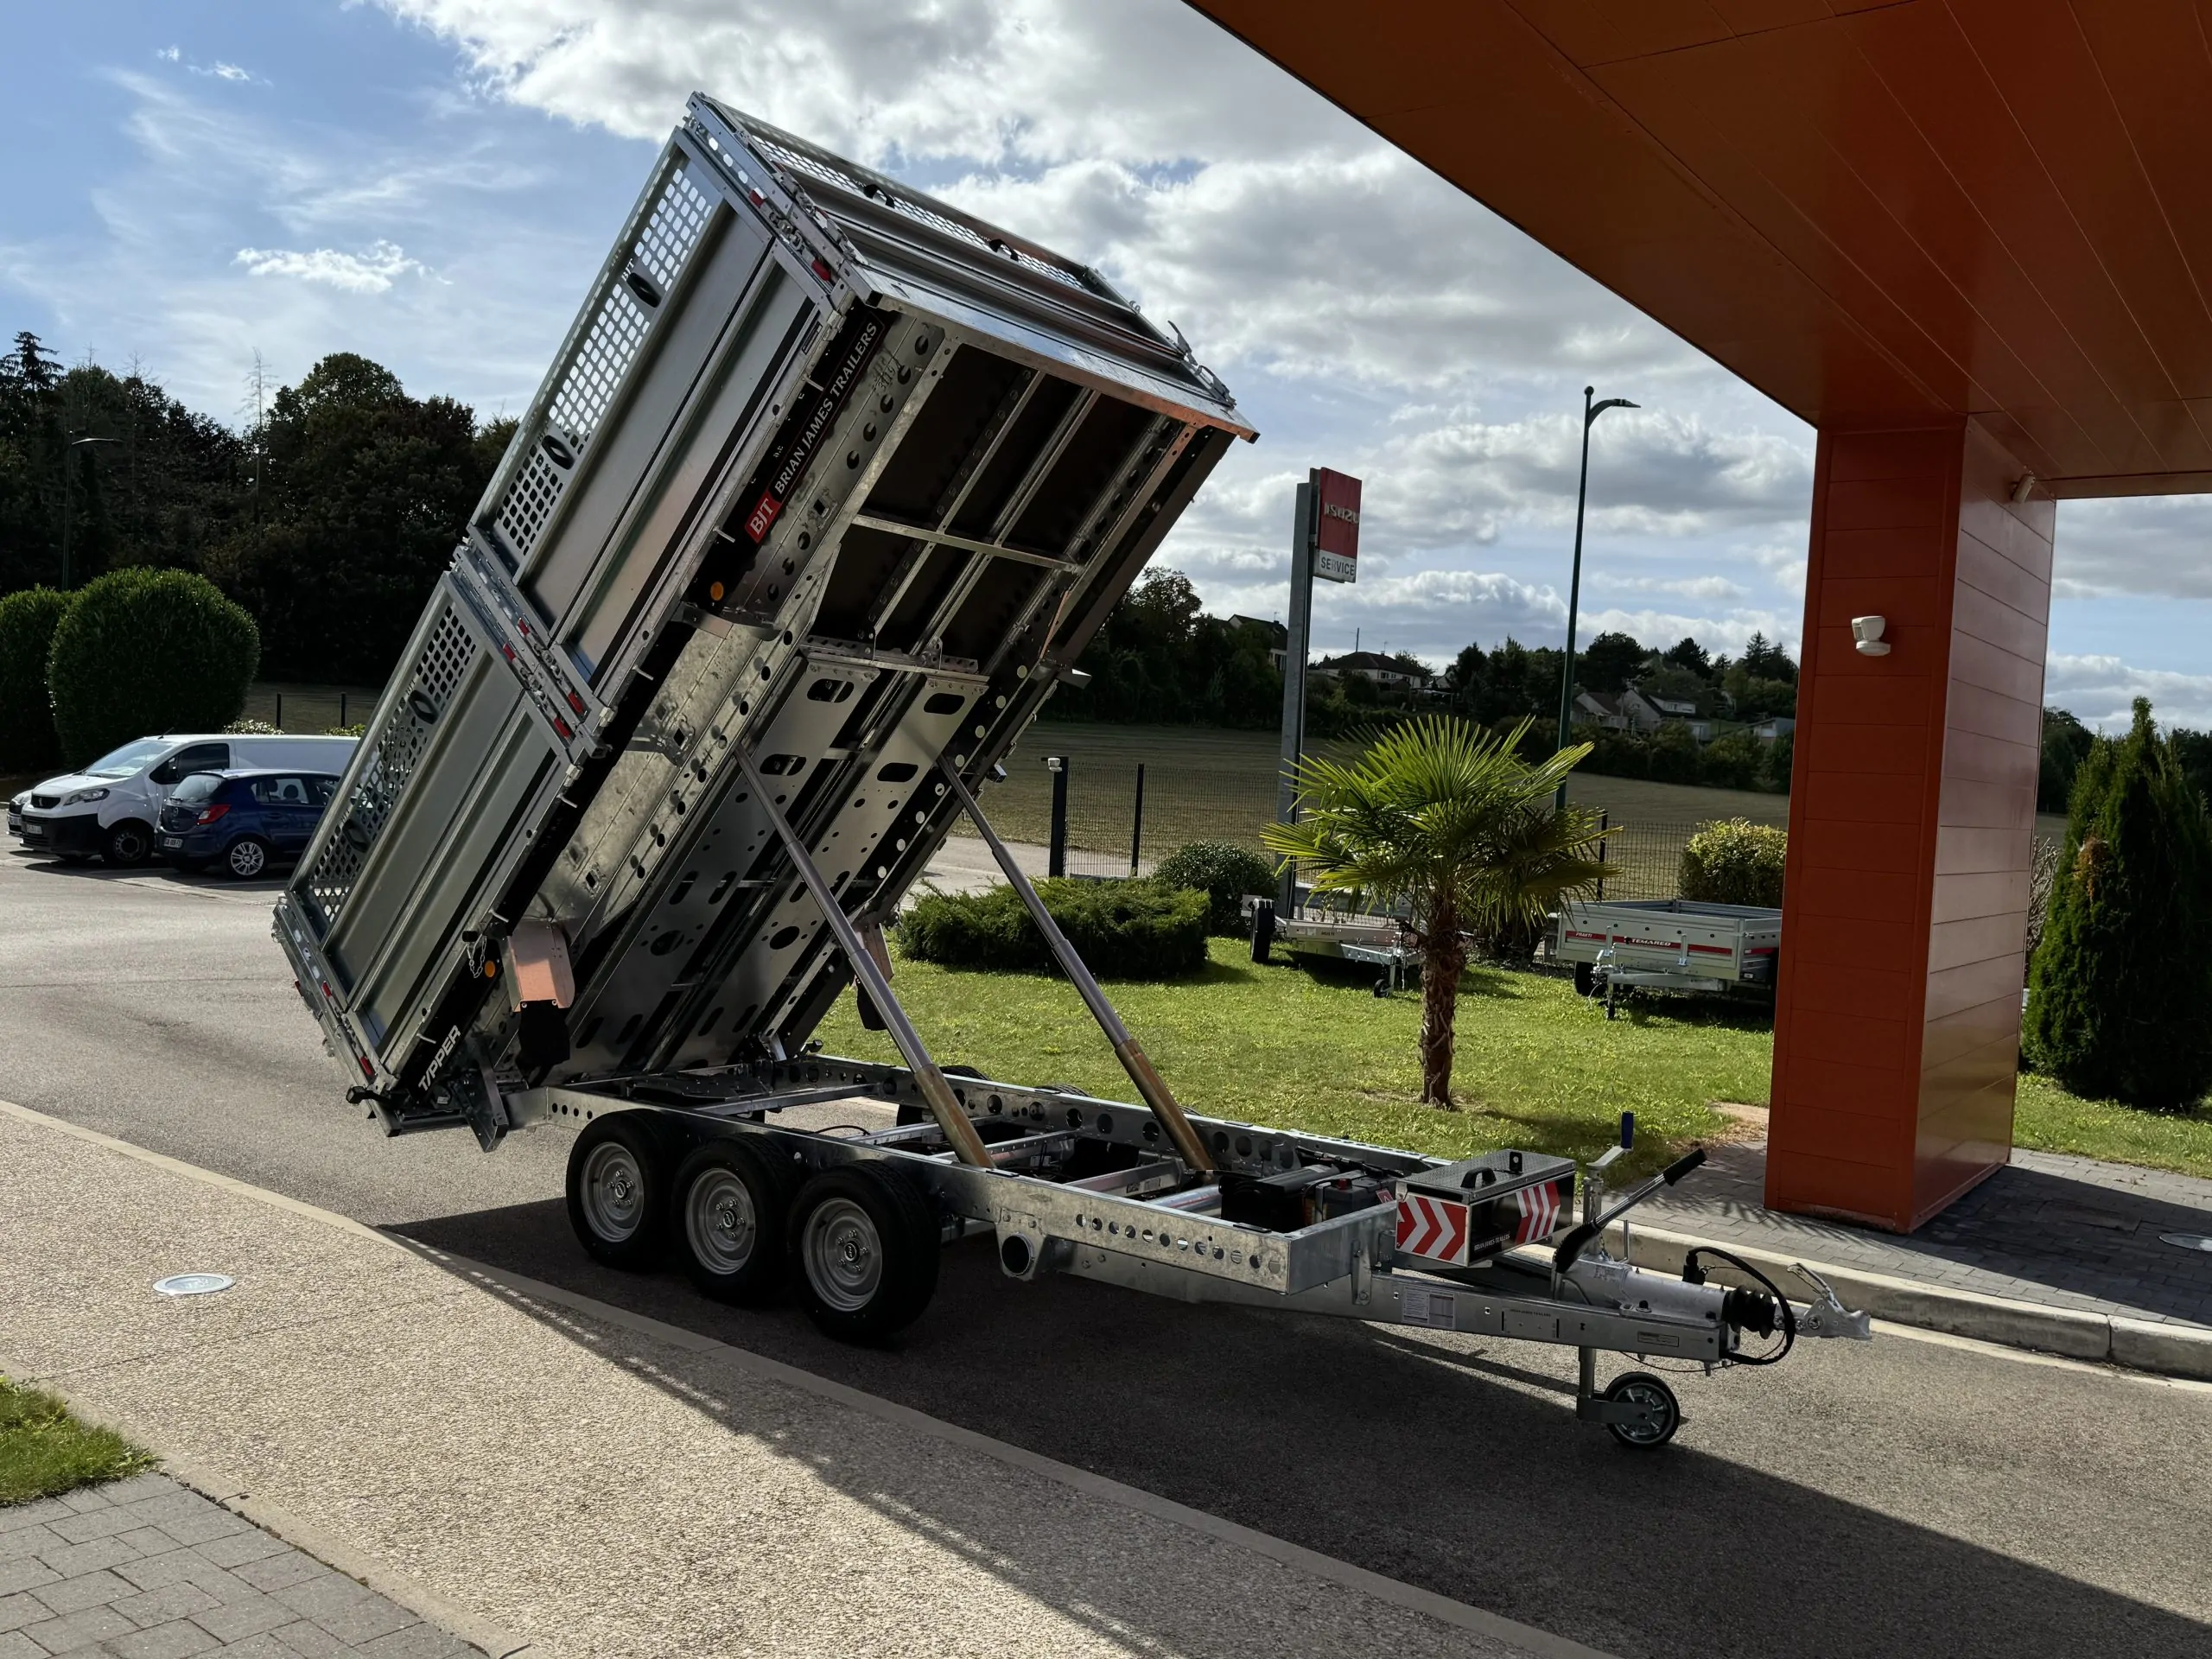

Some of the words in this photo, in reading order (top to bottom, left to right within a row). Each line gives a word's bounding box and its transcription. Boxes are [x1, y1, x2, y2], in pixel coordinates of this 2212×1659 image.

[750, 498, 775, 537] BJT
[774, 447, 805, 495] BRIAN
[801, 398, 834, 449] JAMES
[830, 321, 877, 397] TRAILERS
[1324, 502, 1359, 524] ISUZU
[1320, 556, 1355, 575] SERVICE
[1630, 938, 1671, 947] TEMARED
[418, 1024, 461, 1091] TIPPER
